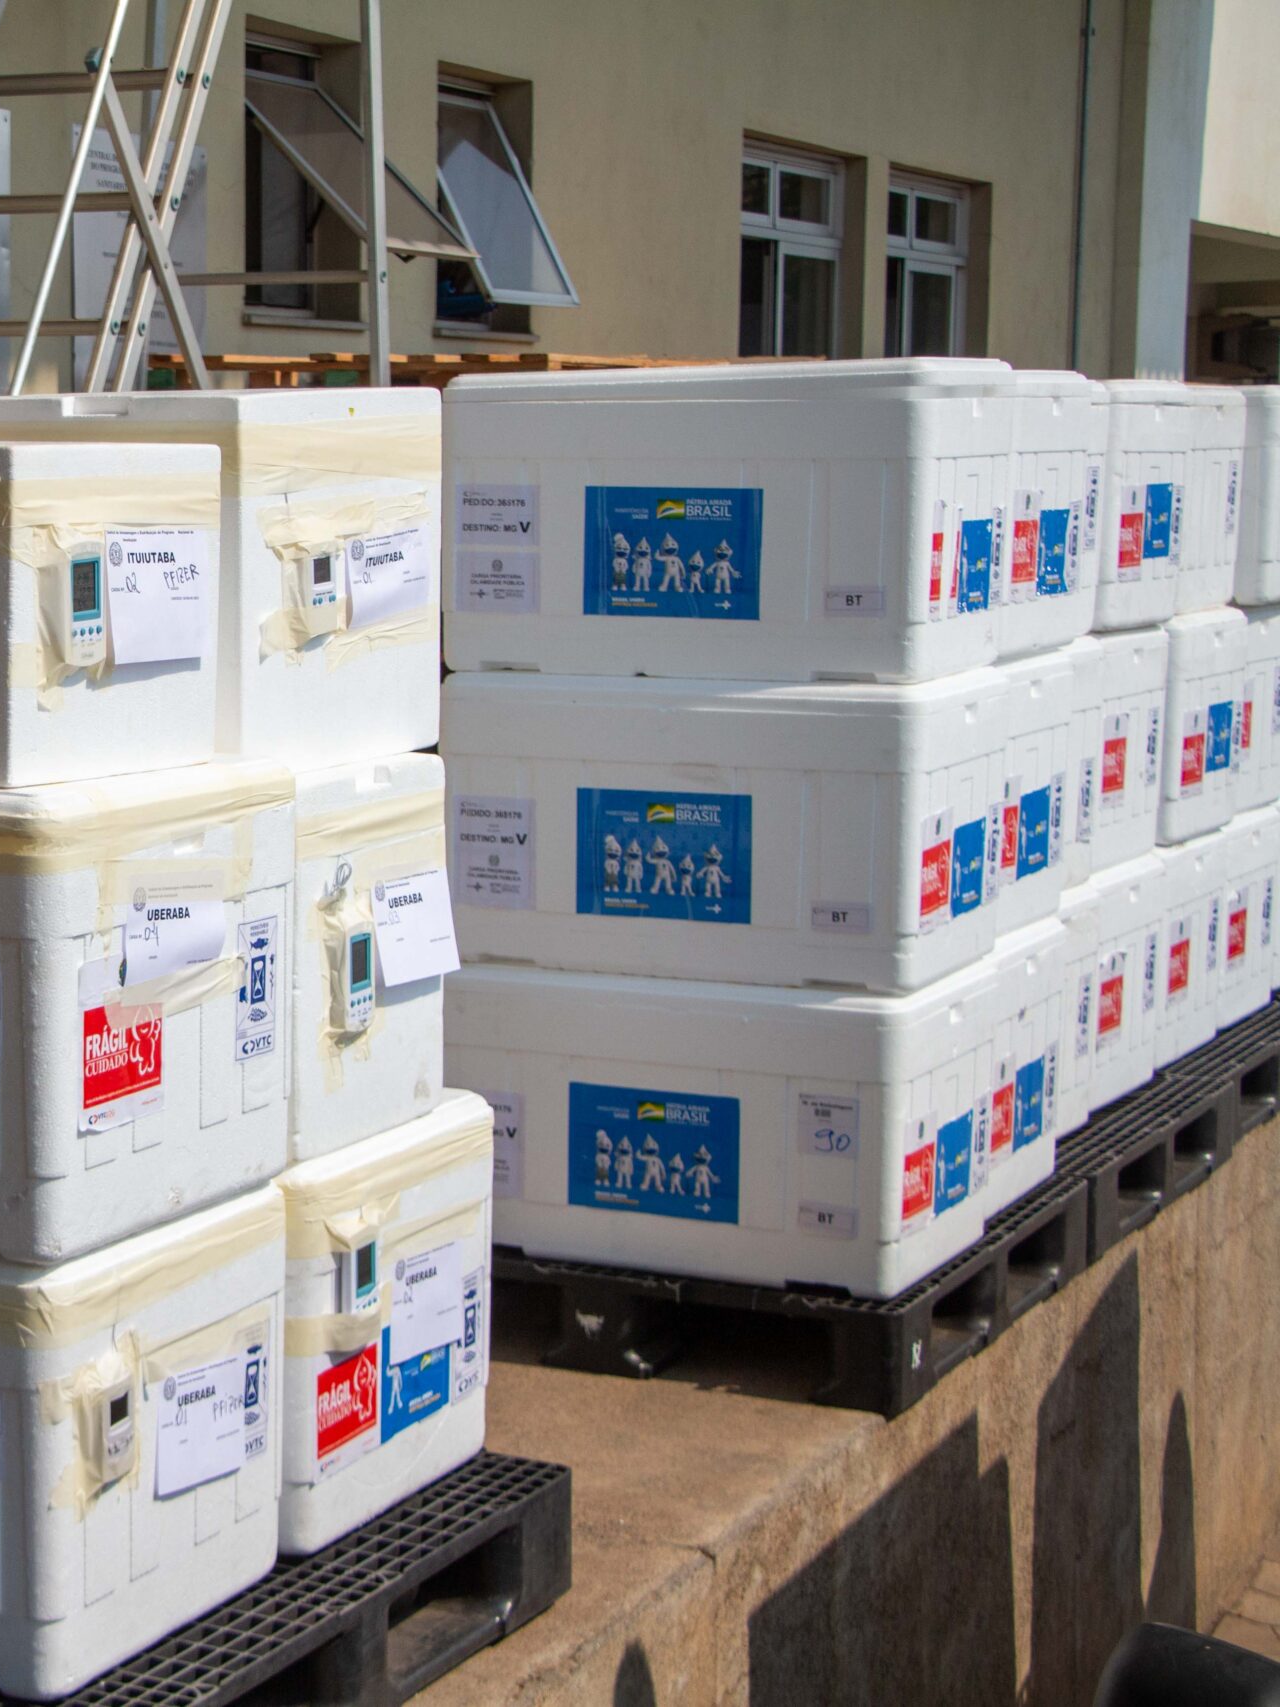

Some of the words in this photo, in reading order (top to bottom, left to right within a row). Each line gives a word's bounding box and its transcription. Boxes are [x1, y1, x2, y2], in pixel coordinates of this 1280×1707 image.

[686, 505, 732, 517] BRASIL
[520, 521, 531, 533] V
[127, 552, 176, 564] ITUIUTABA
[365, 551, 404, 568] ITUIUTABA
[846, 594, 863, 606] BT
[676, 810, 721, 824] BRASIL
[516, 833, 528, 845] V
[388, 892, 423, 909] UBERABA
[147, 907, 190, 921] UBERABA
[832, 911, 848, 923] BT
[86, 1025, 128, 1060] FRÁGIL
[85, 1053, 128, 1078] CUIDADO
[666, 1109, 710, 1124] BRASIL
[818, 1211, 834, 1224] BT
[406, 1266, 437, 1287] UBERABA
[177, 1385, 216, 1407] UBERABA
[319, 1381, 352, 1416] FRÁGIL
